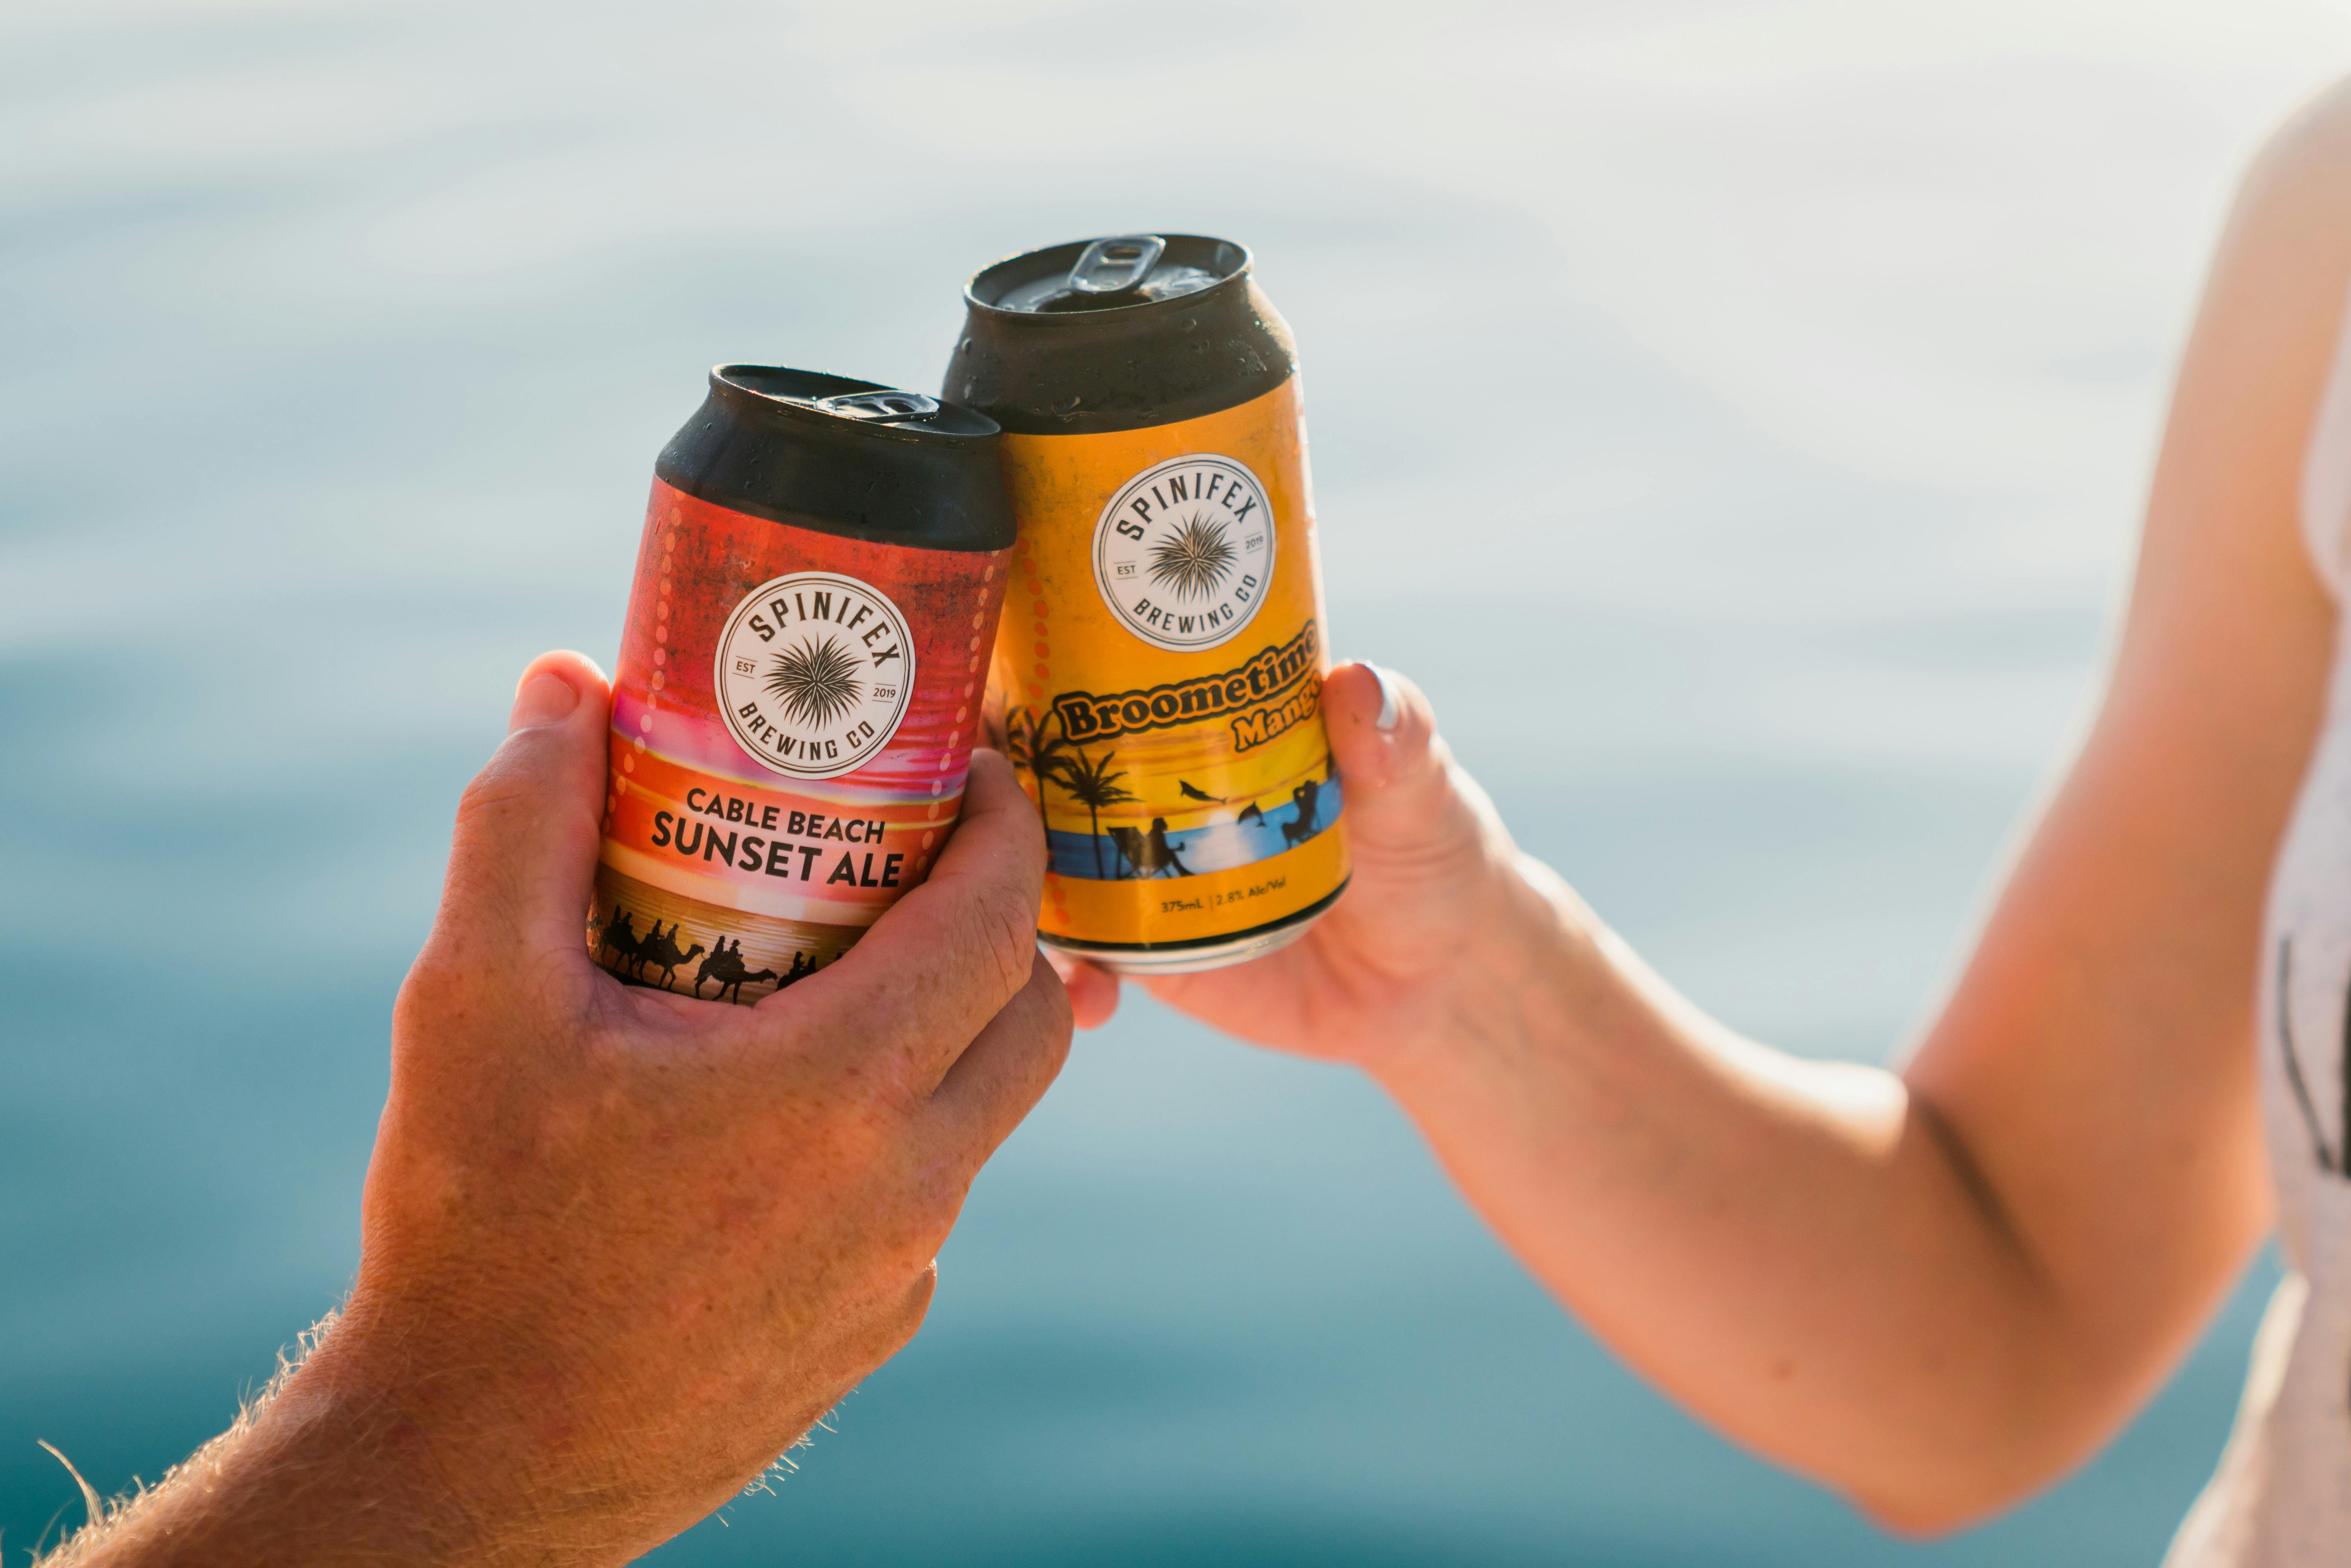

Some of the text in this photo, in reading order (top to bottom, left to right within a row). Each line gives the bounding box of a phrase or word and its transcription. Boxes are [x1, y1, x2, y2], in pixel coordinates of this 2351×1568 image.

[1116, 473, 1257, 541] SPINIFEX
[1117, 536, 1264, 575] EST 2019
[748, 591, 900, 669] SPINIFEX
[1133, 574, 1257, 633] BREWING CO
[736, 661, 896, 699] EST 2019
[1054, 620, 1319, 745] Broometime
[738, 702, 876, 761] BREWING CO
[687, 787, 886, 844] CABLE BEACH
[651, 810, 904, 888] SUNSET ALE
[1161, 876, 1287, 913] 375mL 2.8% Alc/Vol
